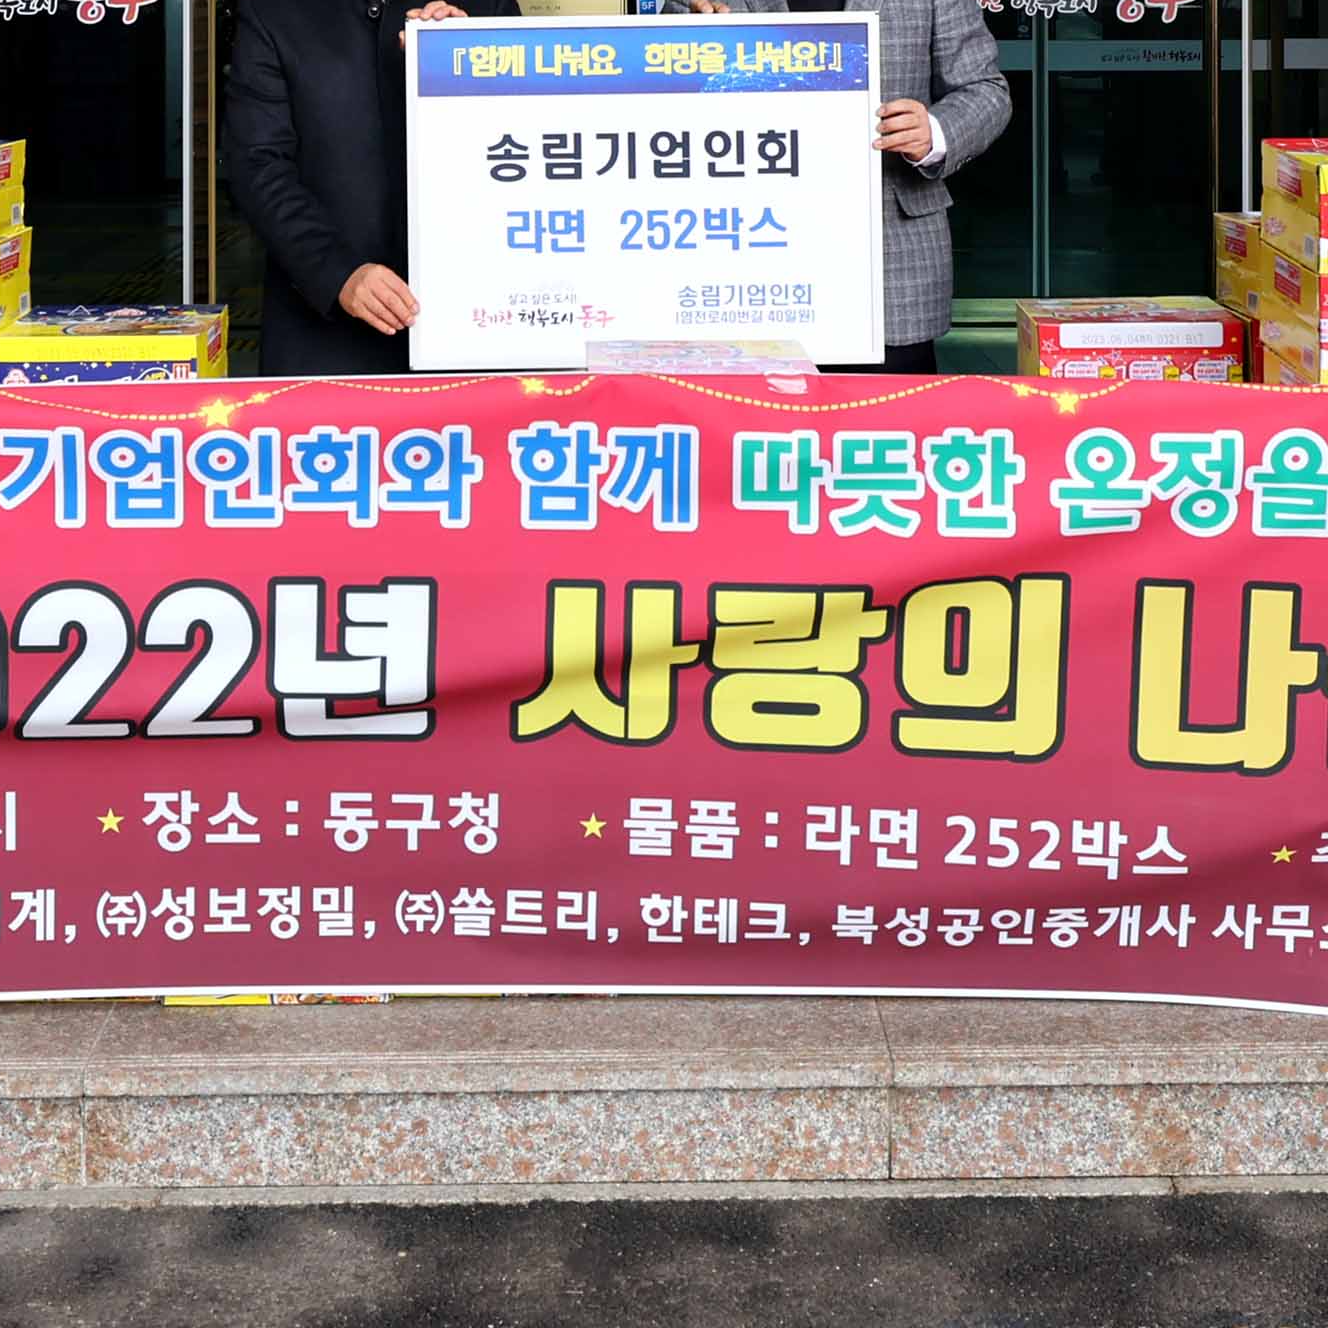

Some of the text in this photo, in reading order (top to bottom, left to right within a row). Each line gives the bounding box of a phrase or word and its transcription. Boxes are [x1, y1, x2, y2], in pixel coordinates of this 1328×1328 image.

[641, 0, 656, 11] 5F
[643, 41, 727, 75] 희망을
[485, 128, 802, 183] 송림기업인회
[505, 206, 789, 255] 라면 252박스
[472, 307, 514, 328] 활기찬
[576, 304, 616, 329] 동구
[676, 283, 814, 308] 송림기업인회
[509, 422, 699, 533] 함께
[732, 428, 1023, 539] 따뜻한
[508, 572, 1071, 765] 사랑의
[141, 789, 262, 854] 장소
[323, 790, 501, 855] 동구청
[623, 796, 742, 860] 물품
[804, 804, 919, 871] 라면
[943, 814, 1190, 881] 252박스
[638, 892, 810, 948] 한테크,
[830, 902, 1196, 948] 북성공인중개사
